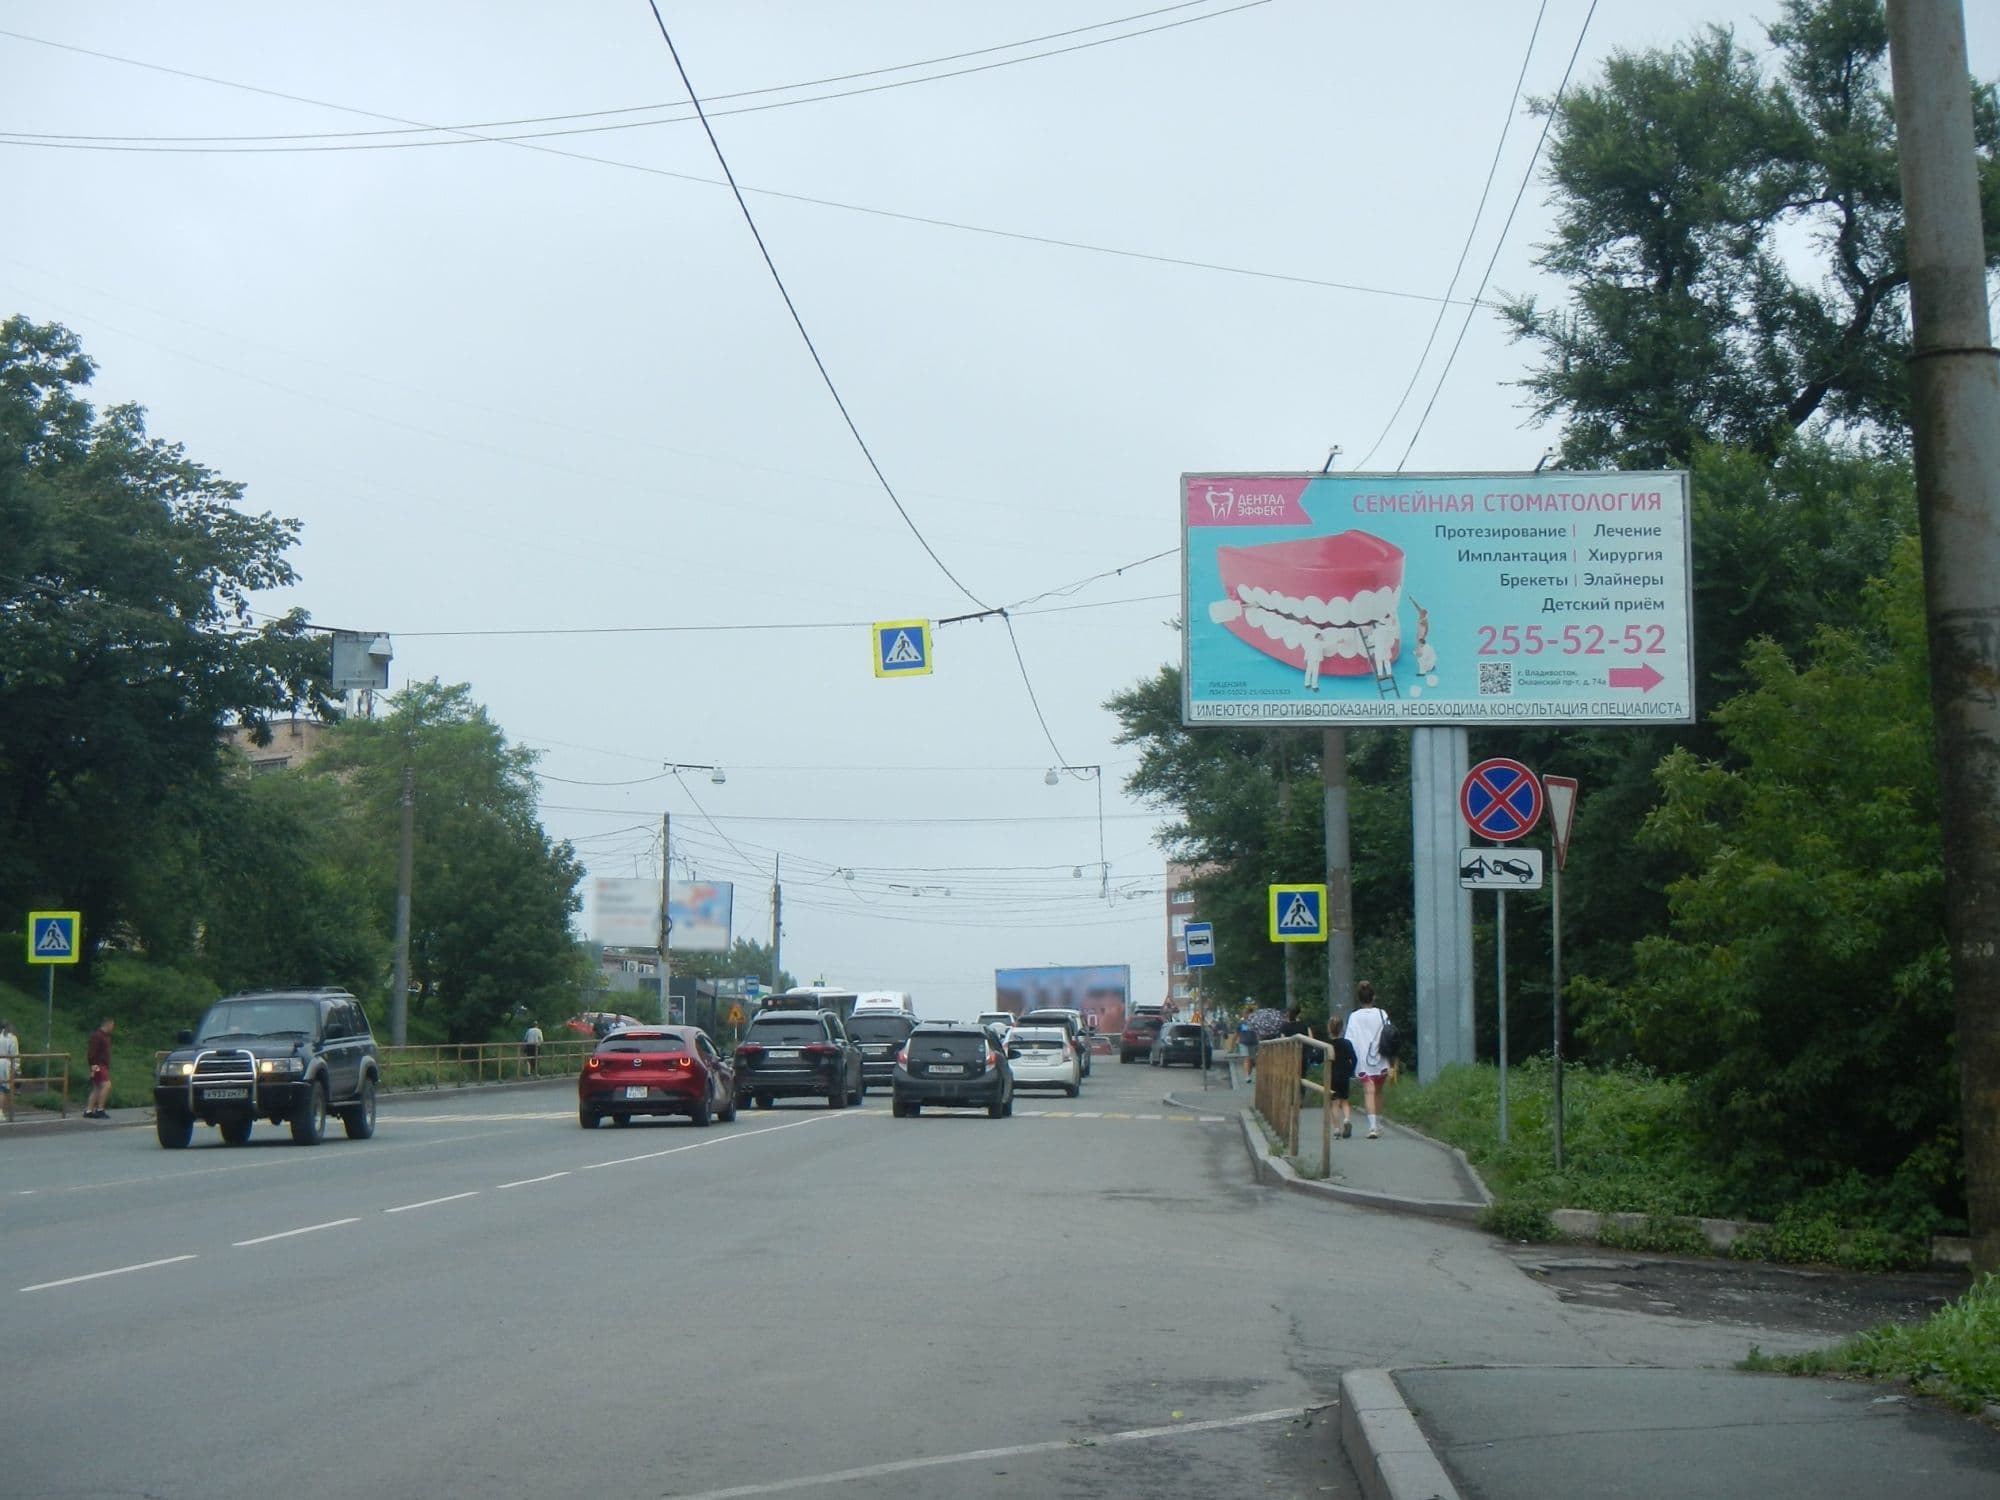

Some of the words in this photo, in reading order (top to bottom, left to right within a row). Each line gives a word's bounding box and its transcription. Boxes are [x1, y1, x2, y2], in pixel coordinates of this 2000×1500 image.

[1238, 494, 1285, 506] ДЕНТАЛ
[1352, 490, 1474, 513] СЕМЕЙНАЯ
[1484, 492, 1662, 512] СТОМАТОЛОГИЯ
[1238, 506, 1285, 516] ЭФФЕКТ
[1435, 525, 1567, 539] Протезирование
[1594, 524, 1662, 537] Лечение
[1457, 550, 1567, 564] Имплантация
[1589, 549, 1663, 564] Хирургия
[1500, 573, 1568, 588] Брекеты
[1584, 572, 1664, 588] Элайнеры
[1542, 598, 1609, 614] Детский
[1614, 598, 1664, 613] приём
[1477, 624, 1667, 655] 255-52-52
[1196, 703, 1259, 717] ИМЕЮТСЯ
[1263, 703, 1398, 717] ПРОТИВОПОКАЗАНИЯ,
[1403, 703, 1486, 717] НЕОБХОДИМА
[1490, 702, 1587, 716] КОНСУЛЬТАЦИЯ
[1590, 702, 1682, 716] СПЕЦИАЛИСТА
